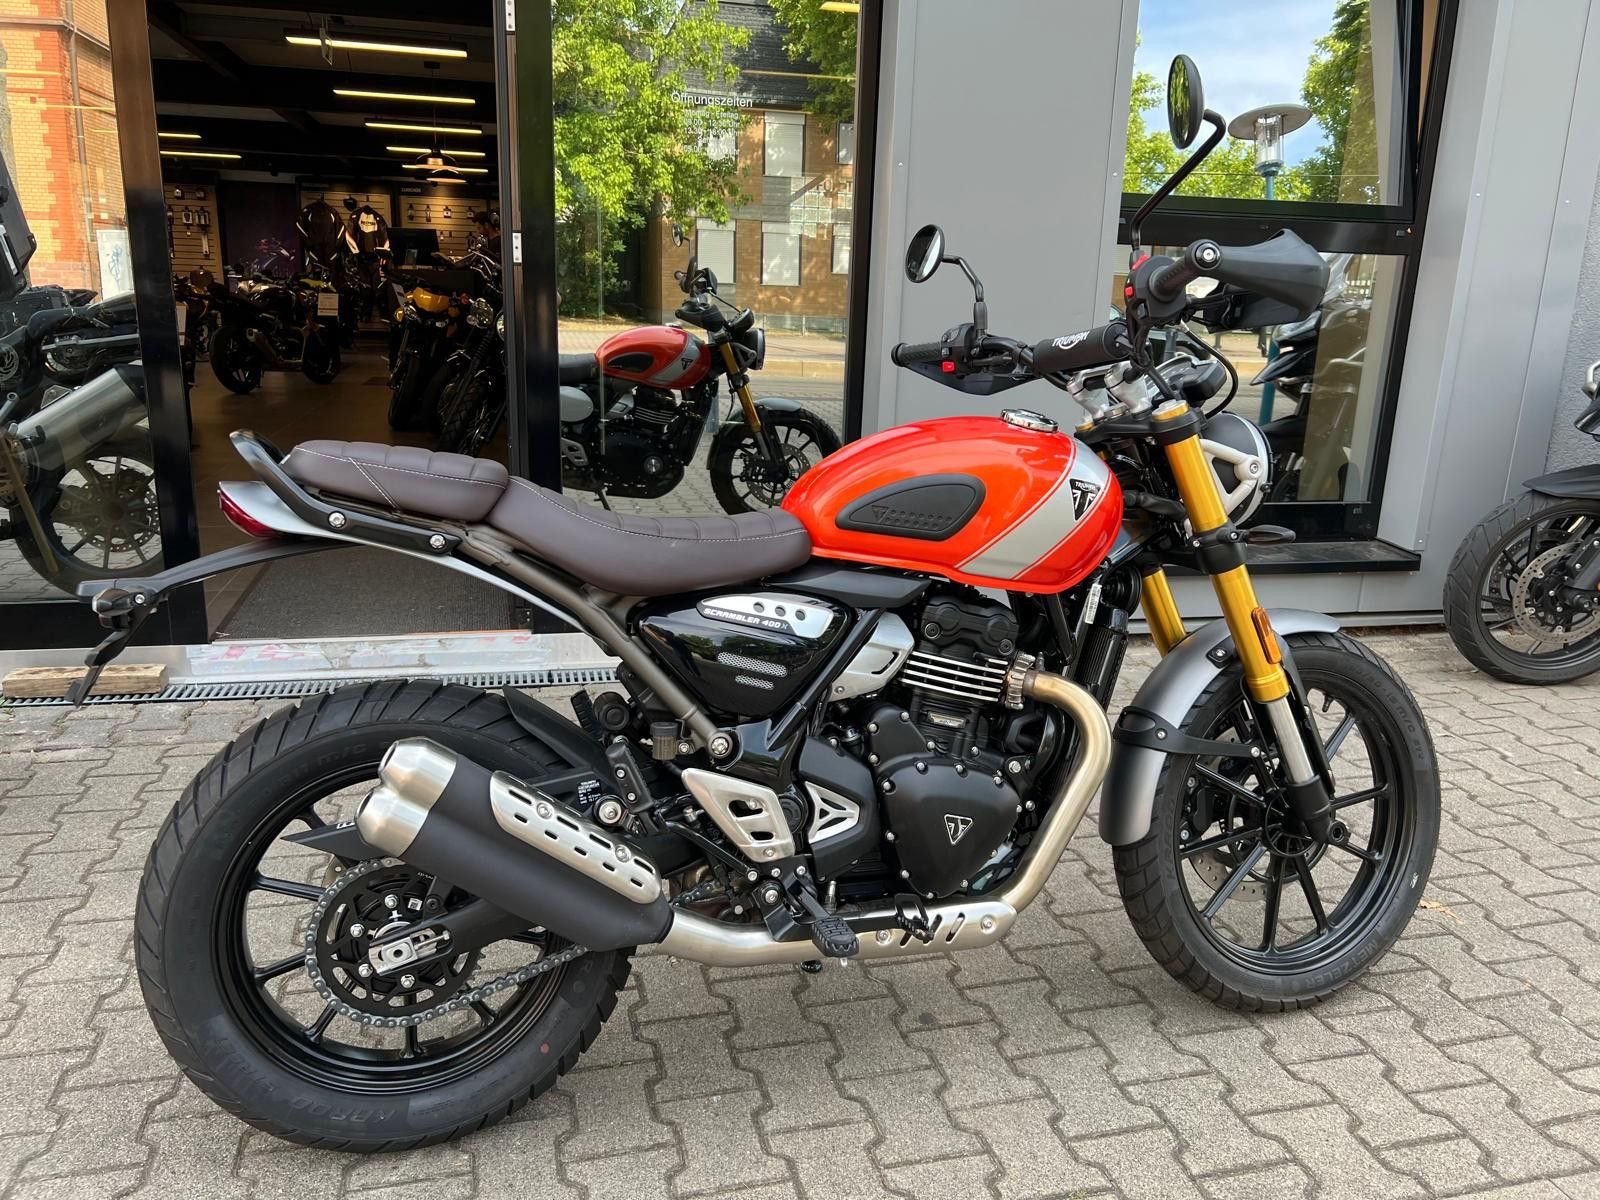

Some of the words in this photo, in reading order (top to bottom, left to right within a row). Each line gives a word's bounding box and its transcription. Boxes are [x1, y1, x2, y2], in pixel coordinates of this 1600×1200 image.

[671, 90, 753, 108] Öffnungszeiten
[1052, 331, 1090, 348] TRIUMPH
[703, 607, 760, 625] SCRAMBLER
[1306, 940, 1379, 989] METZELER
